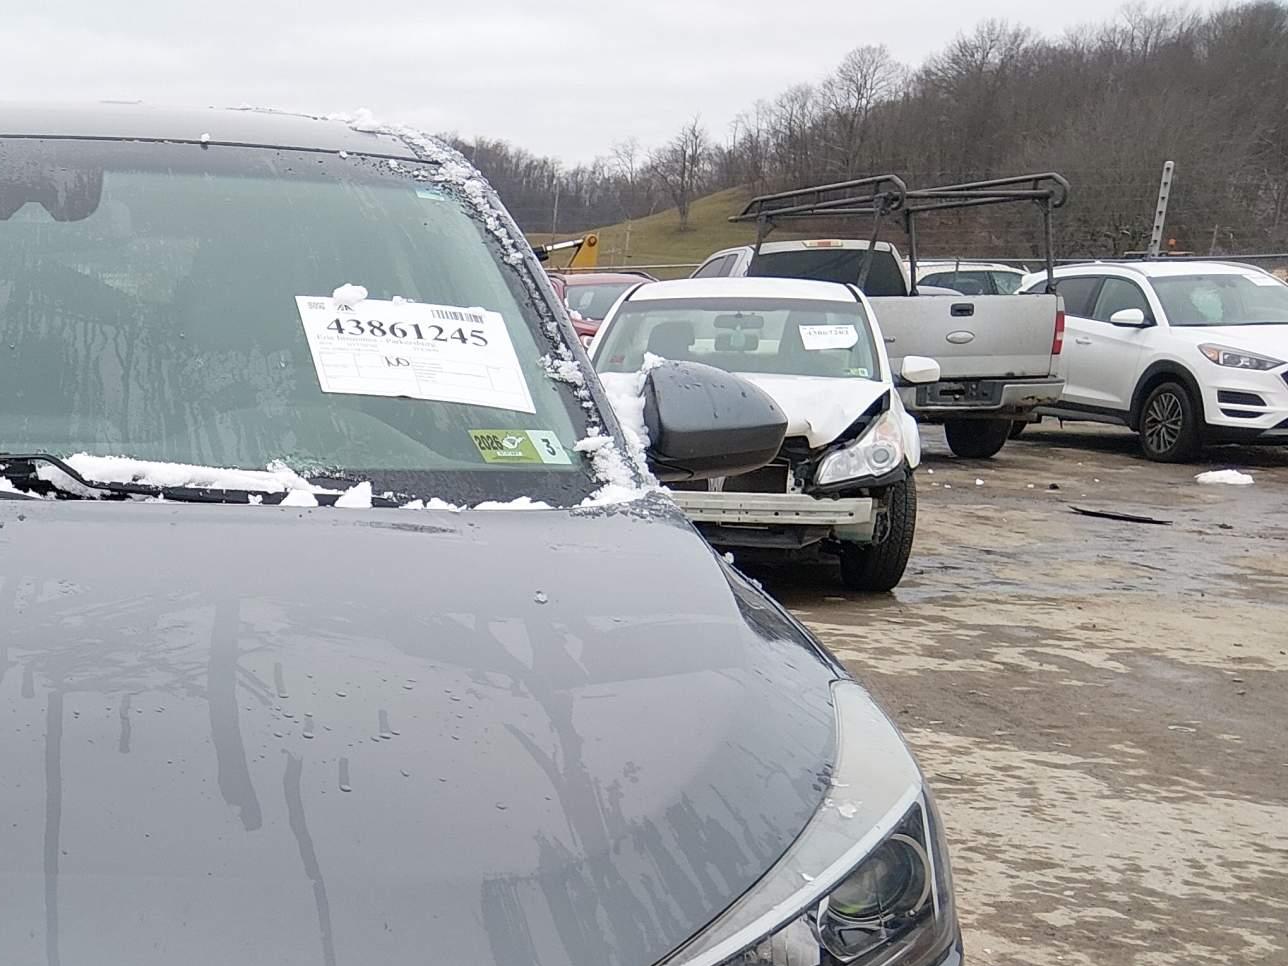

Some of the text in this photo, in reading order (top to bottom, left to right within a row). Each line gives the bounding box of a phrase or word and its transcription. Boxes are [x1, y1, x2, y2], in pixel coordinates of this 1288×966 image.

[326, 317, 488, 347] 43861245
[474, 434, 556, 456] 2026 3
